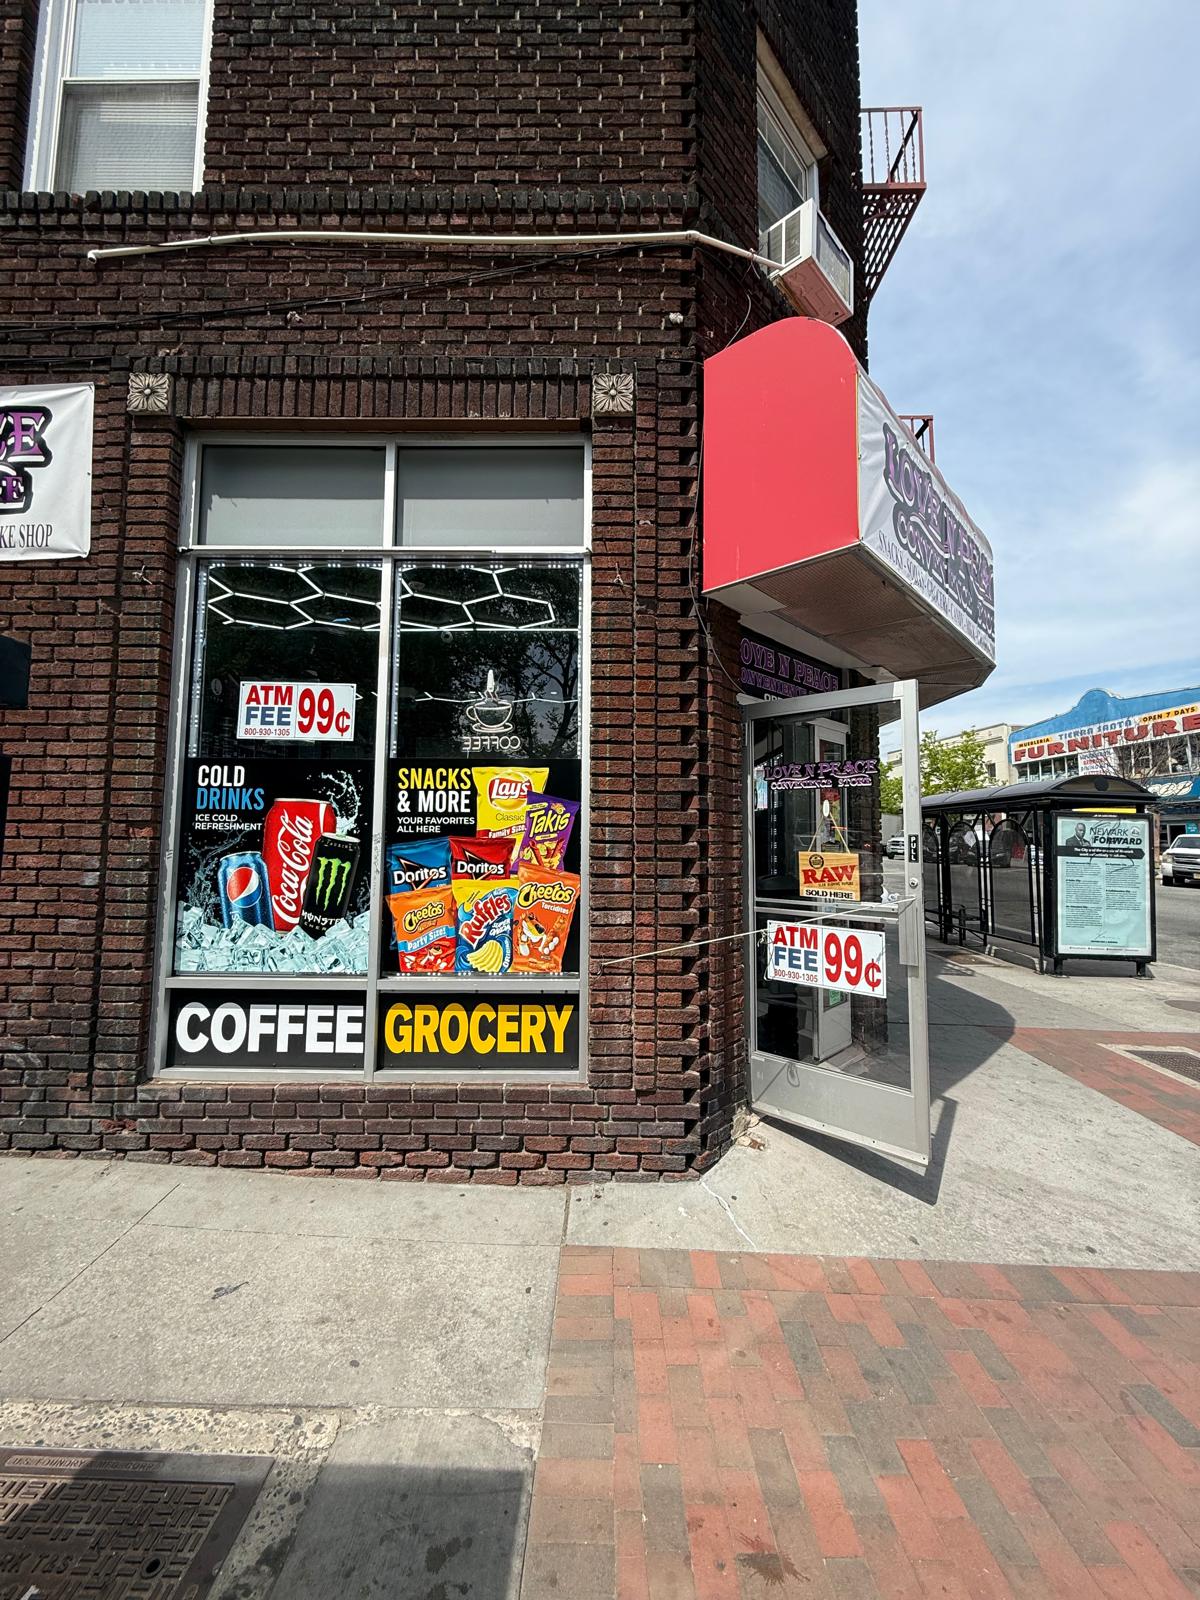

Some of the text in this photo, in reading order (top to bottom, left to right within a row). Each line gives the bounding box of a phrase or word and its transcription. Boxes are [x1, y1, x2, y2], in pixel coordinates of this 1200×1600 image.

[19, 523, 53, 549] SHOP
[740, 637, 775, 674] OVE
[778, 652, 791, 680] N
[245, 684, 294, 706] ATM
[245, 706, 292, 727] FEE
[1141, 713, 1163, 723] OPEN
[1174, 706, 1196, 717] DAYS
[243, 727, 291, 737] 800-930-1305
[1013, 714, 1200, 762] FURNITURE
[198, 764, 246, 788] COLD
[398, 767, 472, 790] SNACKS
[764, 758, 879, 781] LOVE N PEACE
[837, 777, 873, 788] STORE
[196, 787, 265, 811] DRINKS
[397, 790, 471, 813] & MORE
[195, 814, 238, 823] ICE COLD
[195, 822, 263, 831] REFRESHMENT
[397, 816, 475, 826] YOUR FAVORITES
[496, 812, 525, 822] Classic
[529, 809, 571, 838] Takis
[397, 825, 441, 833] ALL HERE
[1089, 826, 1129, 837] NEWARK
[1093, 836, 1142, 845] FORWARD
[393, 866, 447, 885] Doritos
[457, 860, 505, 875] Doritos
[801, 864, 858, 885] RAW
[517, 882, 575, 908] Cheetos
[805, 889, 854, 900] SOLD HERE
[404, 903, 444, 933] Cheetos
[459, 893, 512, 948] Ruffles
[407, 935, 428, 951] Party
[773, 924, 819, 950] ATM
[773, 946, 819, 973] FEE
[773, 968, 819, 983] 800-930-1305
[175, 1001, 365, 1055] COFFEE
[384, 1001, 575, 1055] GROCERY
